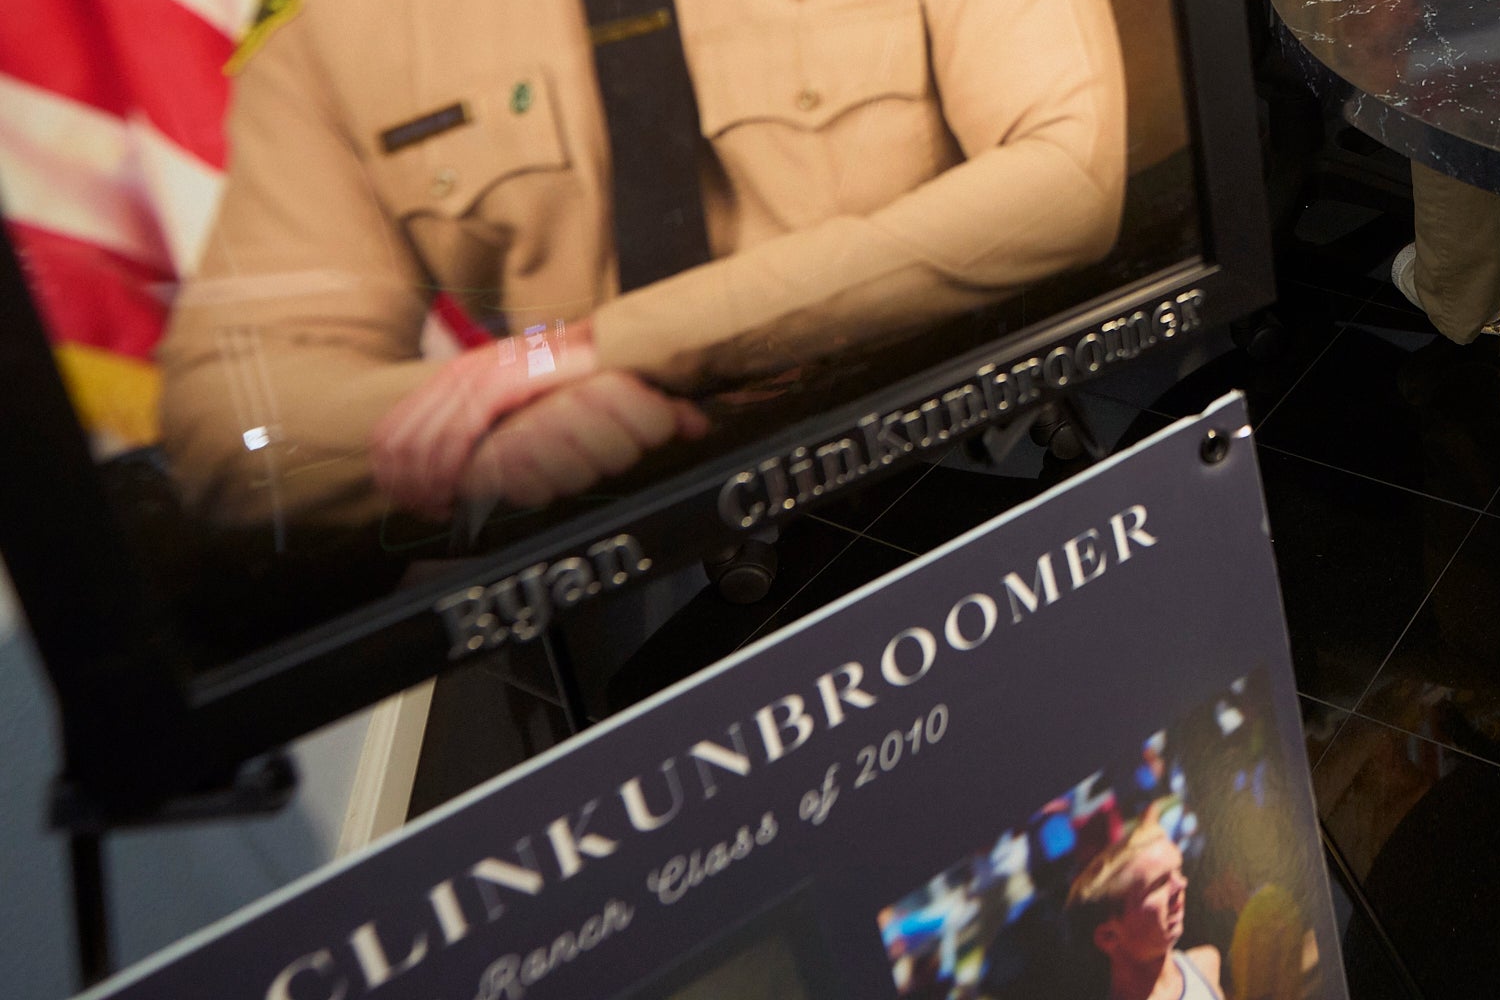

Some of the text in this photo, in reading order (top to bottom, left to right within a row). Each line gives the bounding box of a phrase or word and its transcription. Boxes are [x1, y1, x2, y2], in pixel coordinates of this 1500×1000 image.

[434, 288, 1207, 660] Ryan Clinkunbroomer
[265, 504, 1159, 1000] CLINKUNBROOMER
[646, 811, 779, 905] Class
[799, 761, 841, 826] of
[853, 702, 950, 790] 2010
